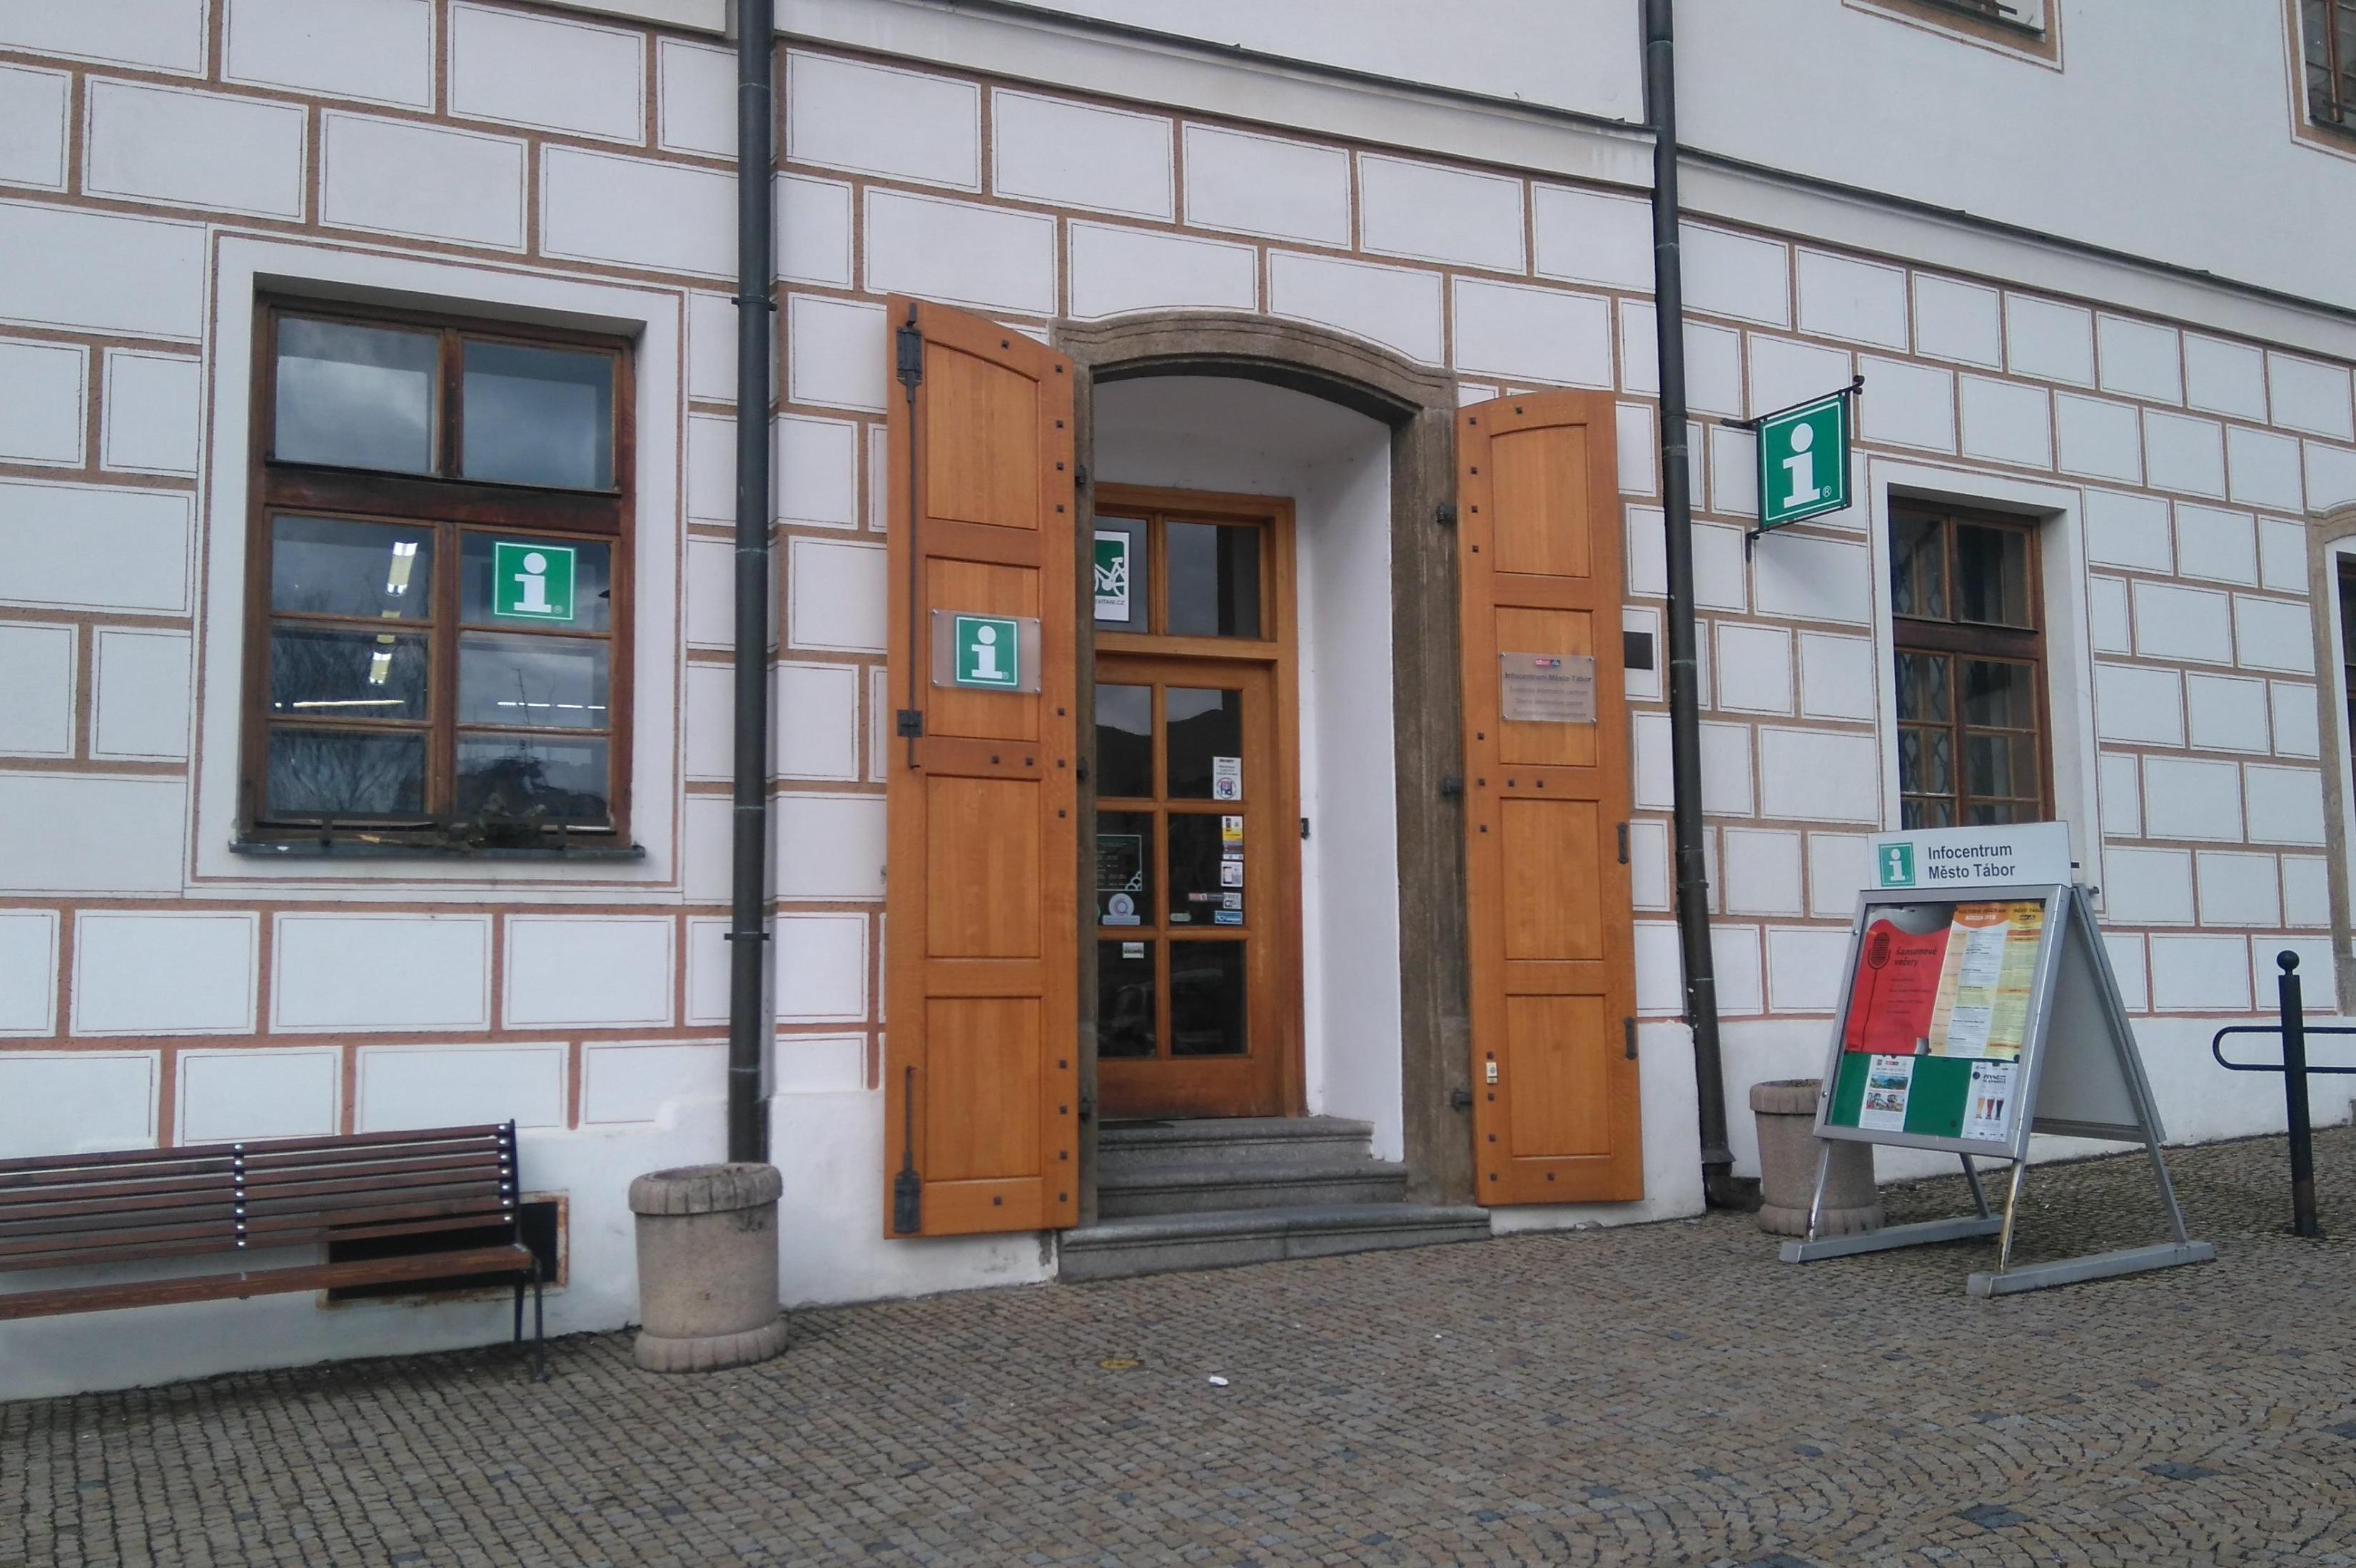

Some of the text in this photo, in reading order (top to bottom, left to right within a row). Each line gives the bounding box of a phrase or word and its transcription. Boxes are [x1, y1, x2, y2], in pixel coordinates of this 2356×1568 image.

[1928, 844, 2013, 860] Infocentrum
[1928, 863, 2015, 879] Město Tábor
